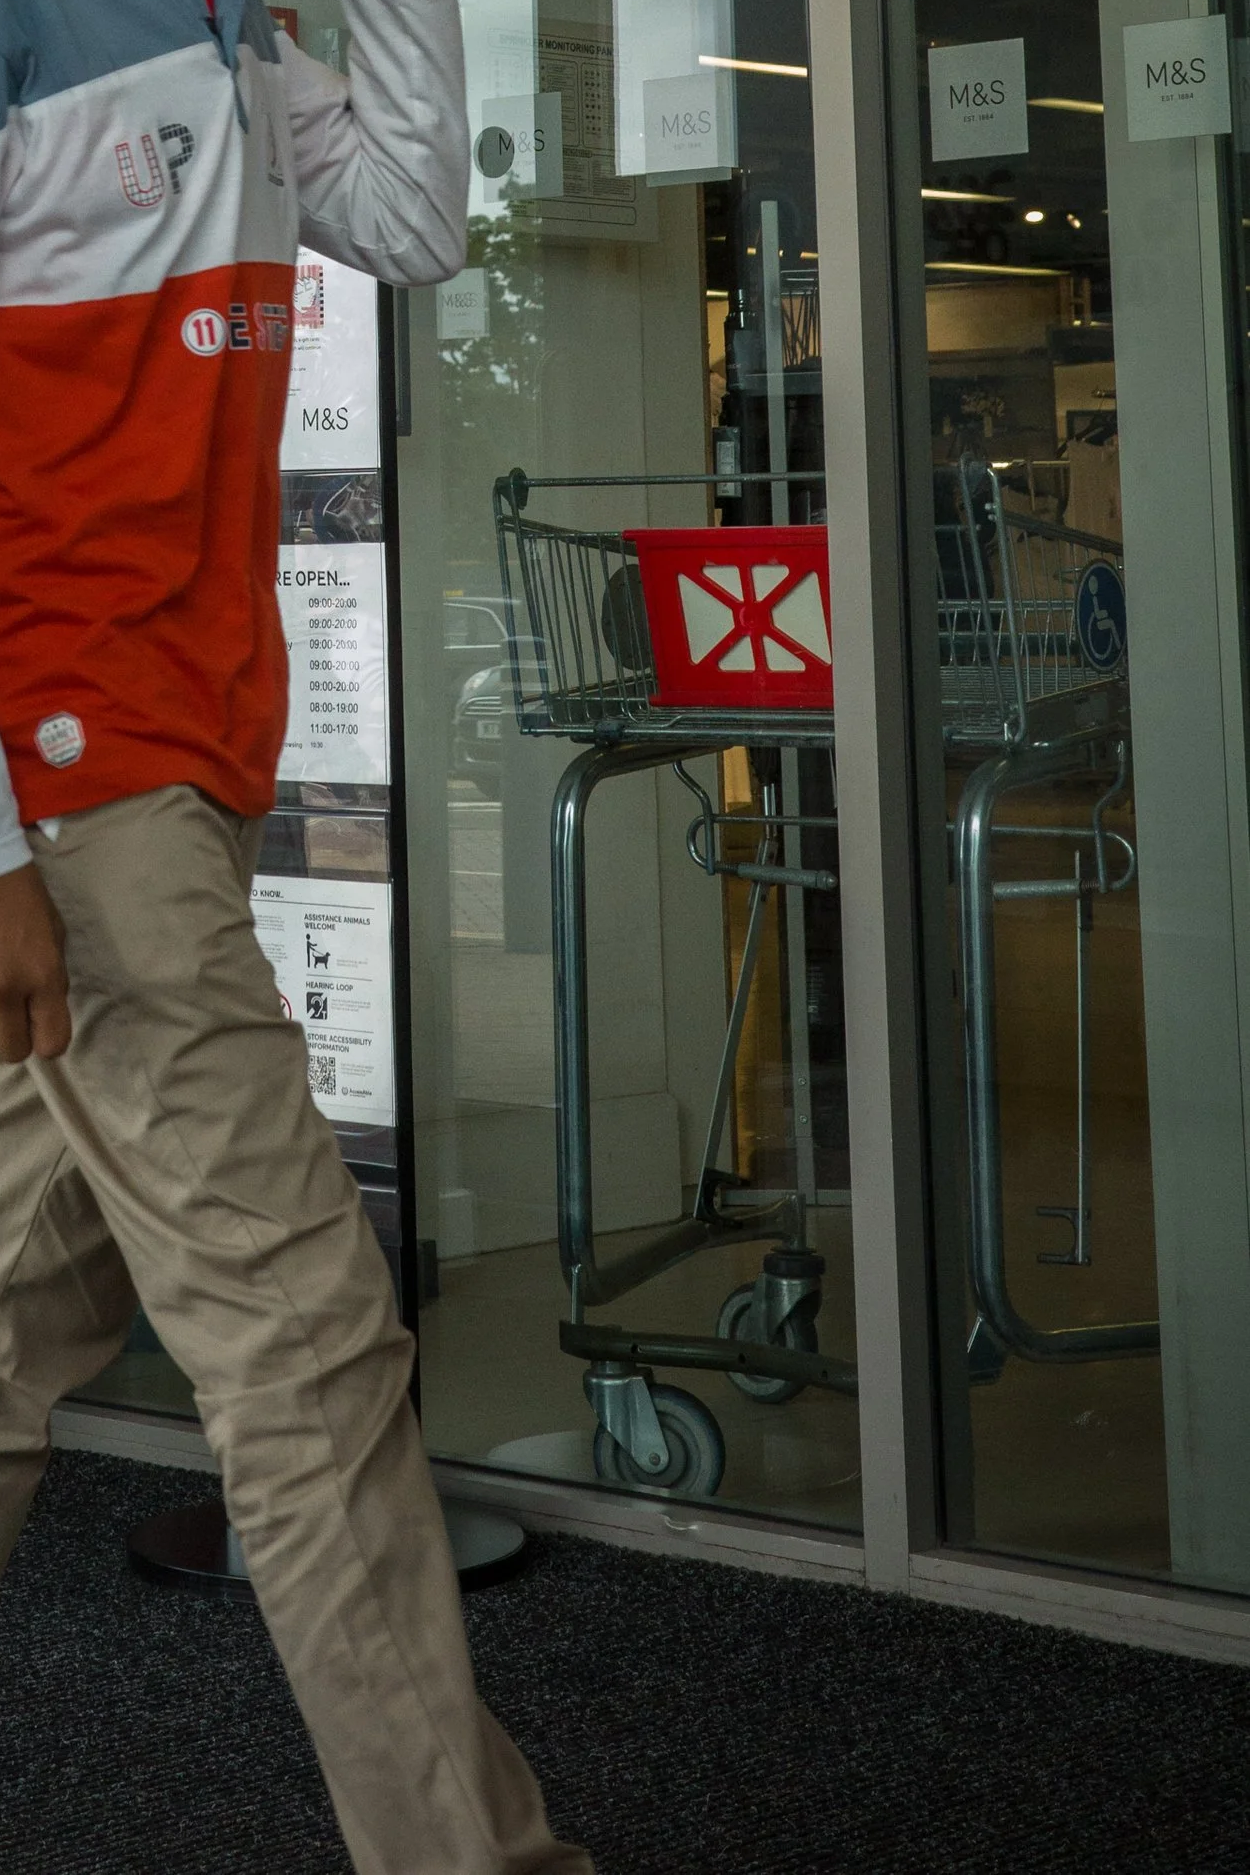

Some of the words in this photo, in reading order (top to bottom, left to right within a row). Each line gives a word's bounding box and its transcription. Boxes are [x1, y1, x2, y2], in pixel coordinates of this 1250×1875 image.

[546, 39, 595, 55] MONITORING
[1146, 57, 1206, 88] M&S
[949, 79, 1004, 110] M&S
[661, 110, 712, 138] M&S
[498, 128, 545, 156] M&S
[192, 316, 216, 347] 11
[302, 406, 350, 432] M&S
[276, 571, 292, 586] RE
[295, 570, 351, 587] OPEN...
[308, 597, 357, 609] 09:00-20:00
[308, 618, 358, 629] 09:00-20:00
[309, 639, 358, 650] 09:00-20:00
[309, 660, 360, 671] 09:00-20:00
[309, 681, 360, 692] 09:00-20:00
[309, 702, 359, 714] 08:00-19:00
[310, 723, 359, 735] 11:00-17:00
[304, 913, 342, 924] ASSISTANCE
[343, 916, 371, 925] ANIMALS
[304, 922, 336, 931] WELCOME
[306, 981, 335, 990] HEARING
[336, 984, 354, 992] LOOP
[307, 1033, 327, 1042] STORE
[329, 1035, 373, 1047] ACCESSIBILITY
[307, 1042, 350, 1053] INFORMATION
